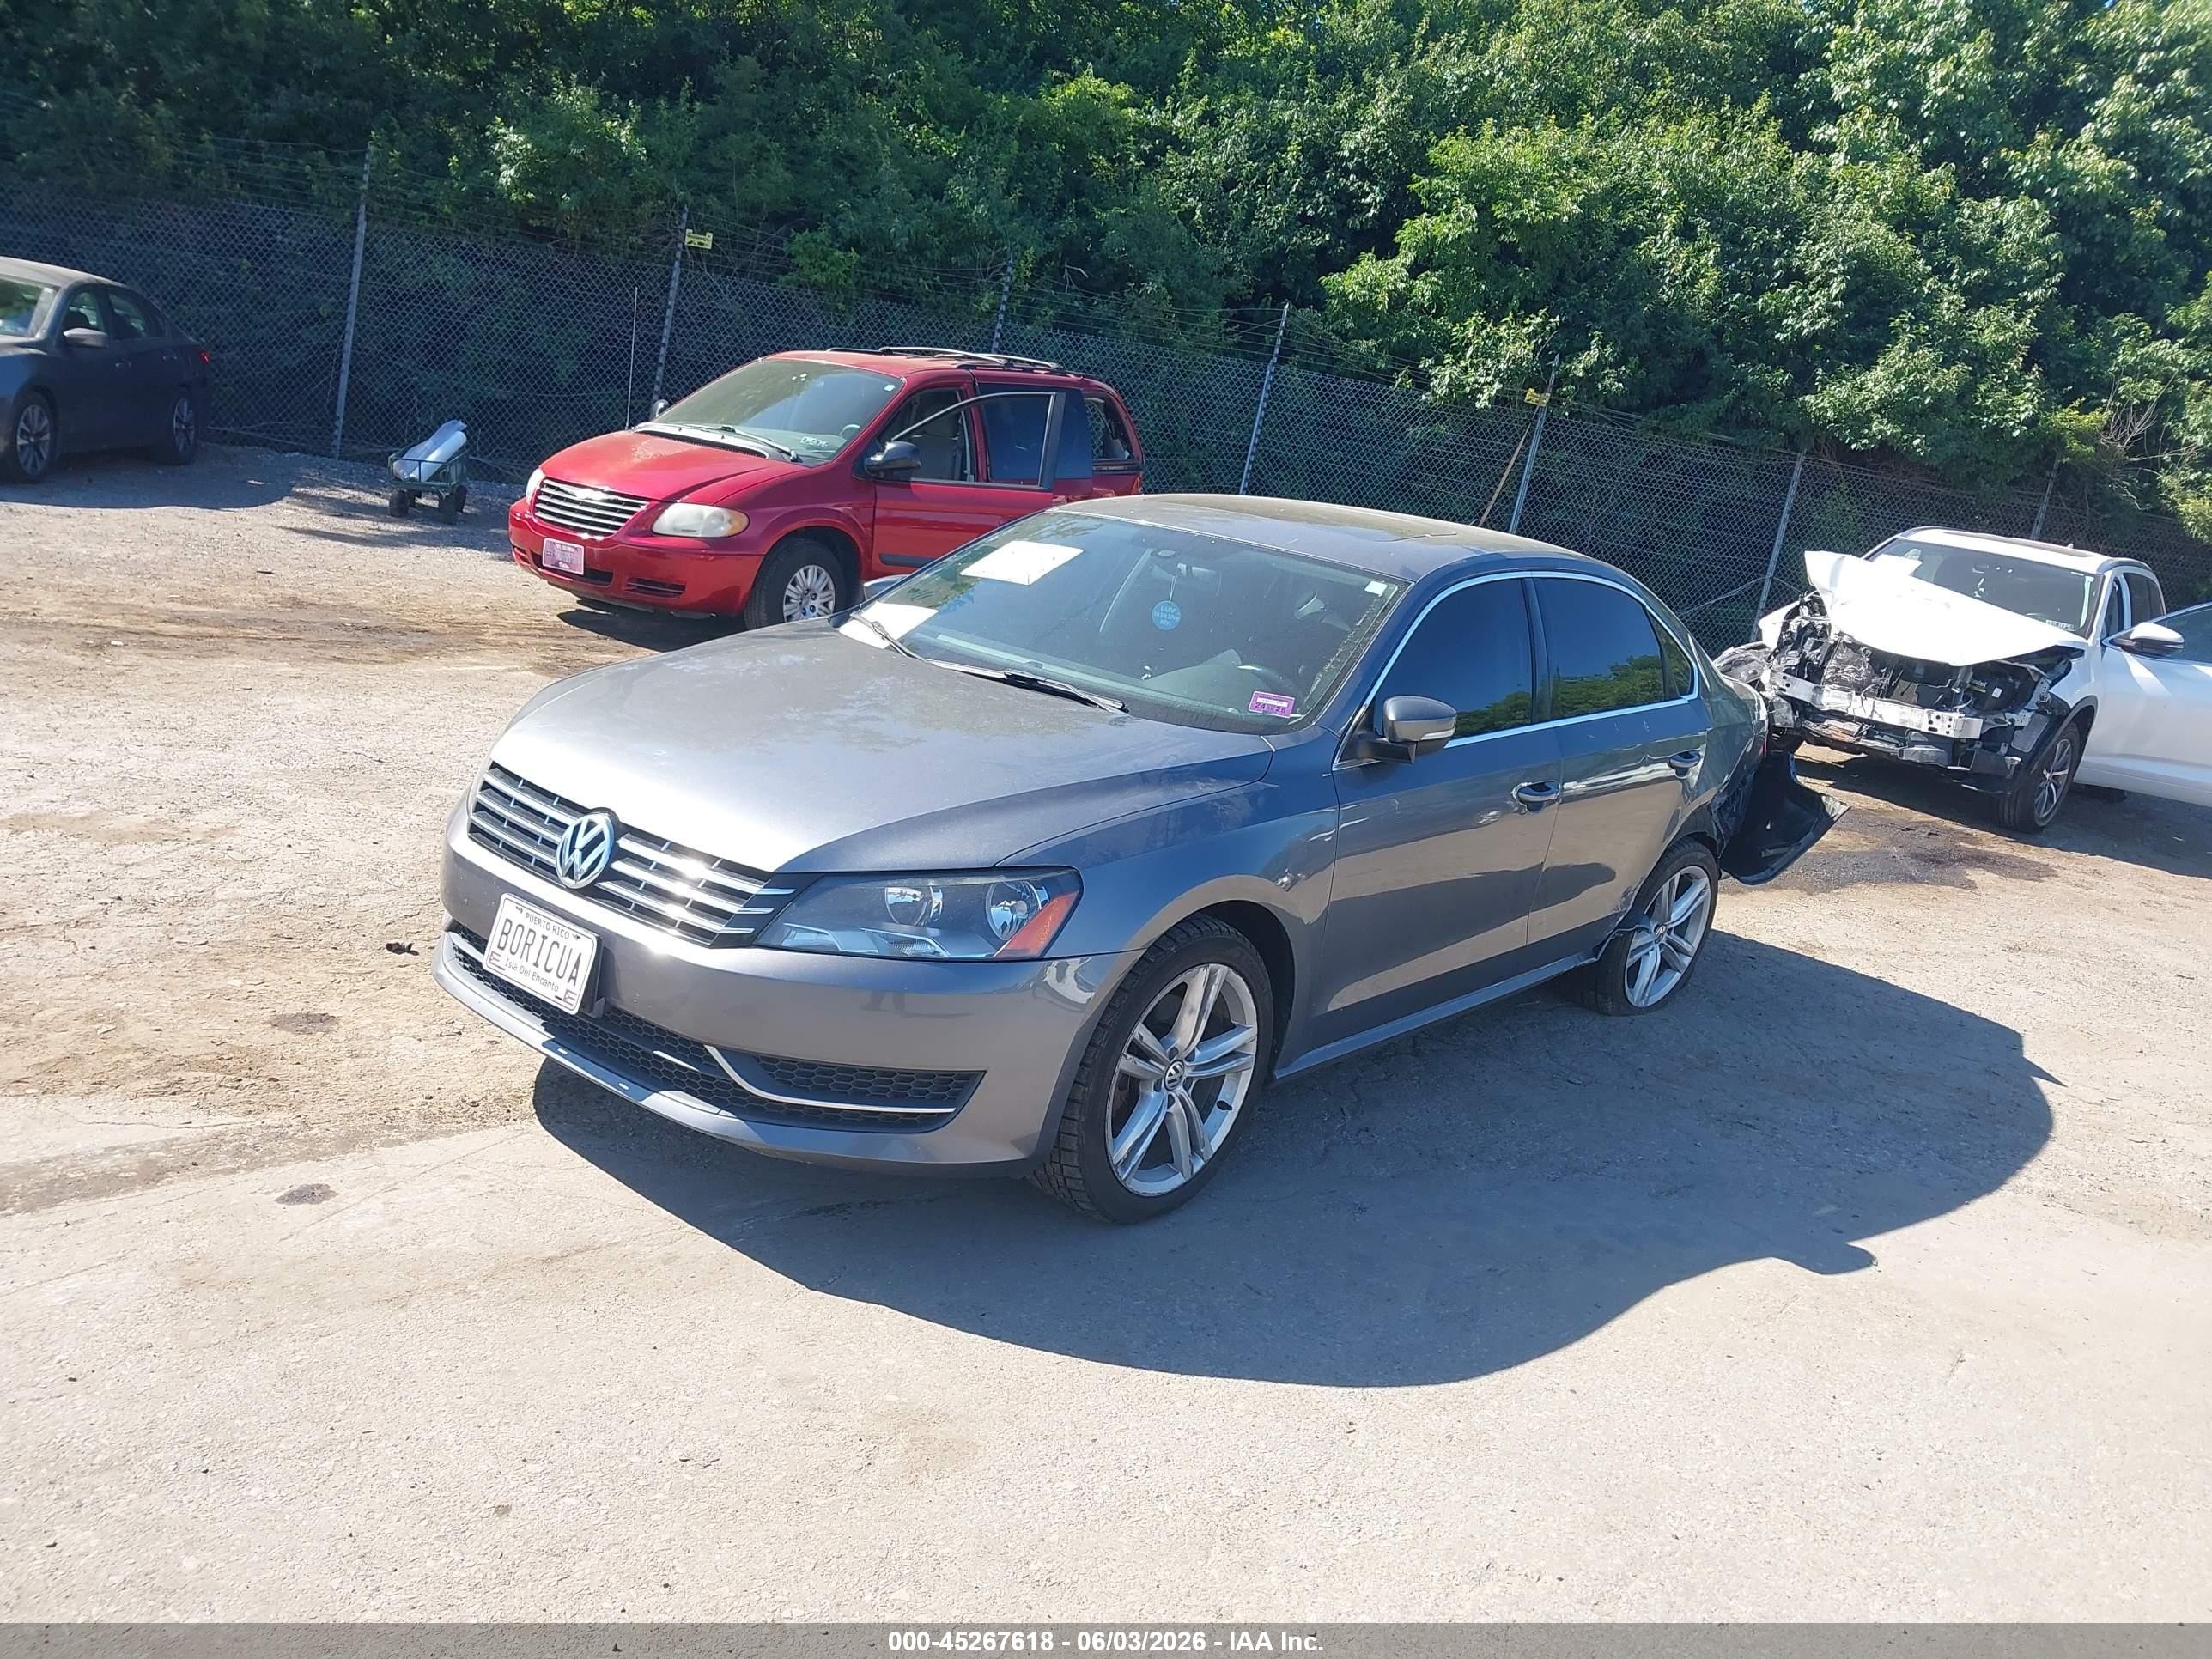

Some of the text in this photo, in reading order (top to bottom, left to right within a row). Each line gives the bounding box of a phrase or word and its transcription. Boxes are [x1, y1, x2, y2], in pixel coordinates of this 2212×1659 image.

[525, 912, 570, 940] PUERTO RICO
[496, 918, 582, 988] BORICUA
[504, 957, 560, 993] Isla Del Encanto
